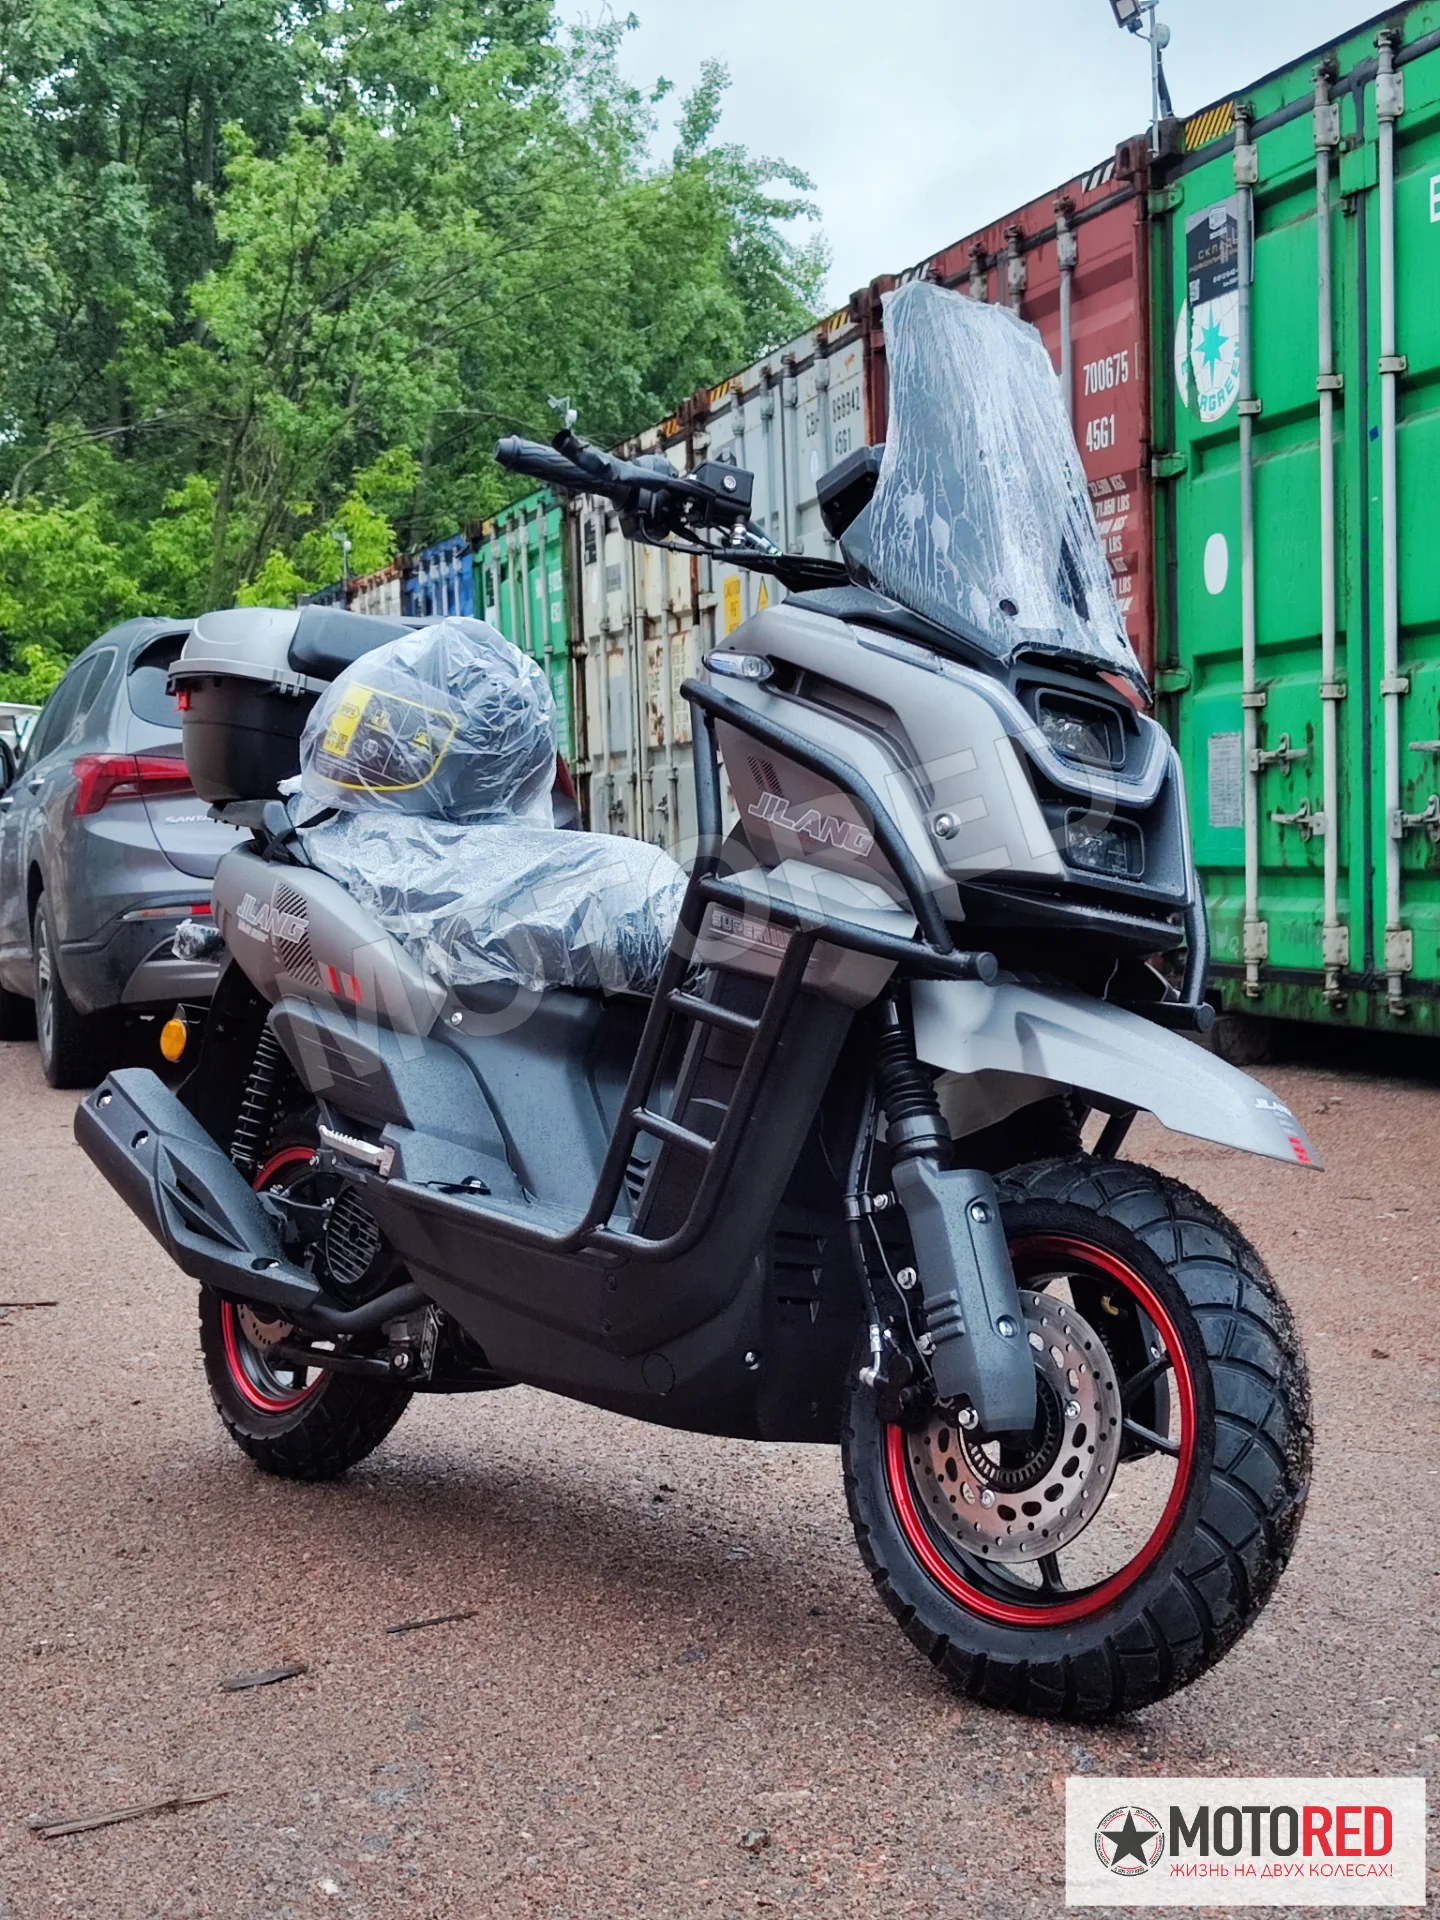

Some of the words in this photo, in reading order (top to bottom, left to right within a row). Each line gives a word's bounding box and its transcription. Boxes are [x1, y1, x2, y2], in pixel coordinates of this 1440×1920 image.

[1083, 350, 1129, 396] 700675
[1085, 414, 1115, 452] 45G1
[1117, 494, 1130, 512] LBS
[1109, 535, 1123, 553] LBS
[1119, 576, 1132, 594] LBS
[748, 791, 875, 857] JILANG
[236, 892, 309, 944] JILANG
